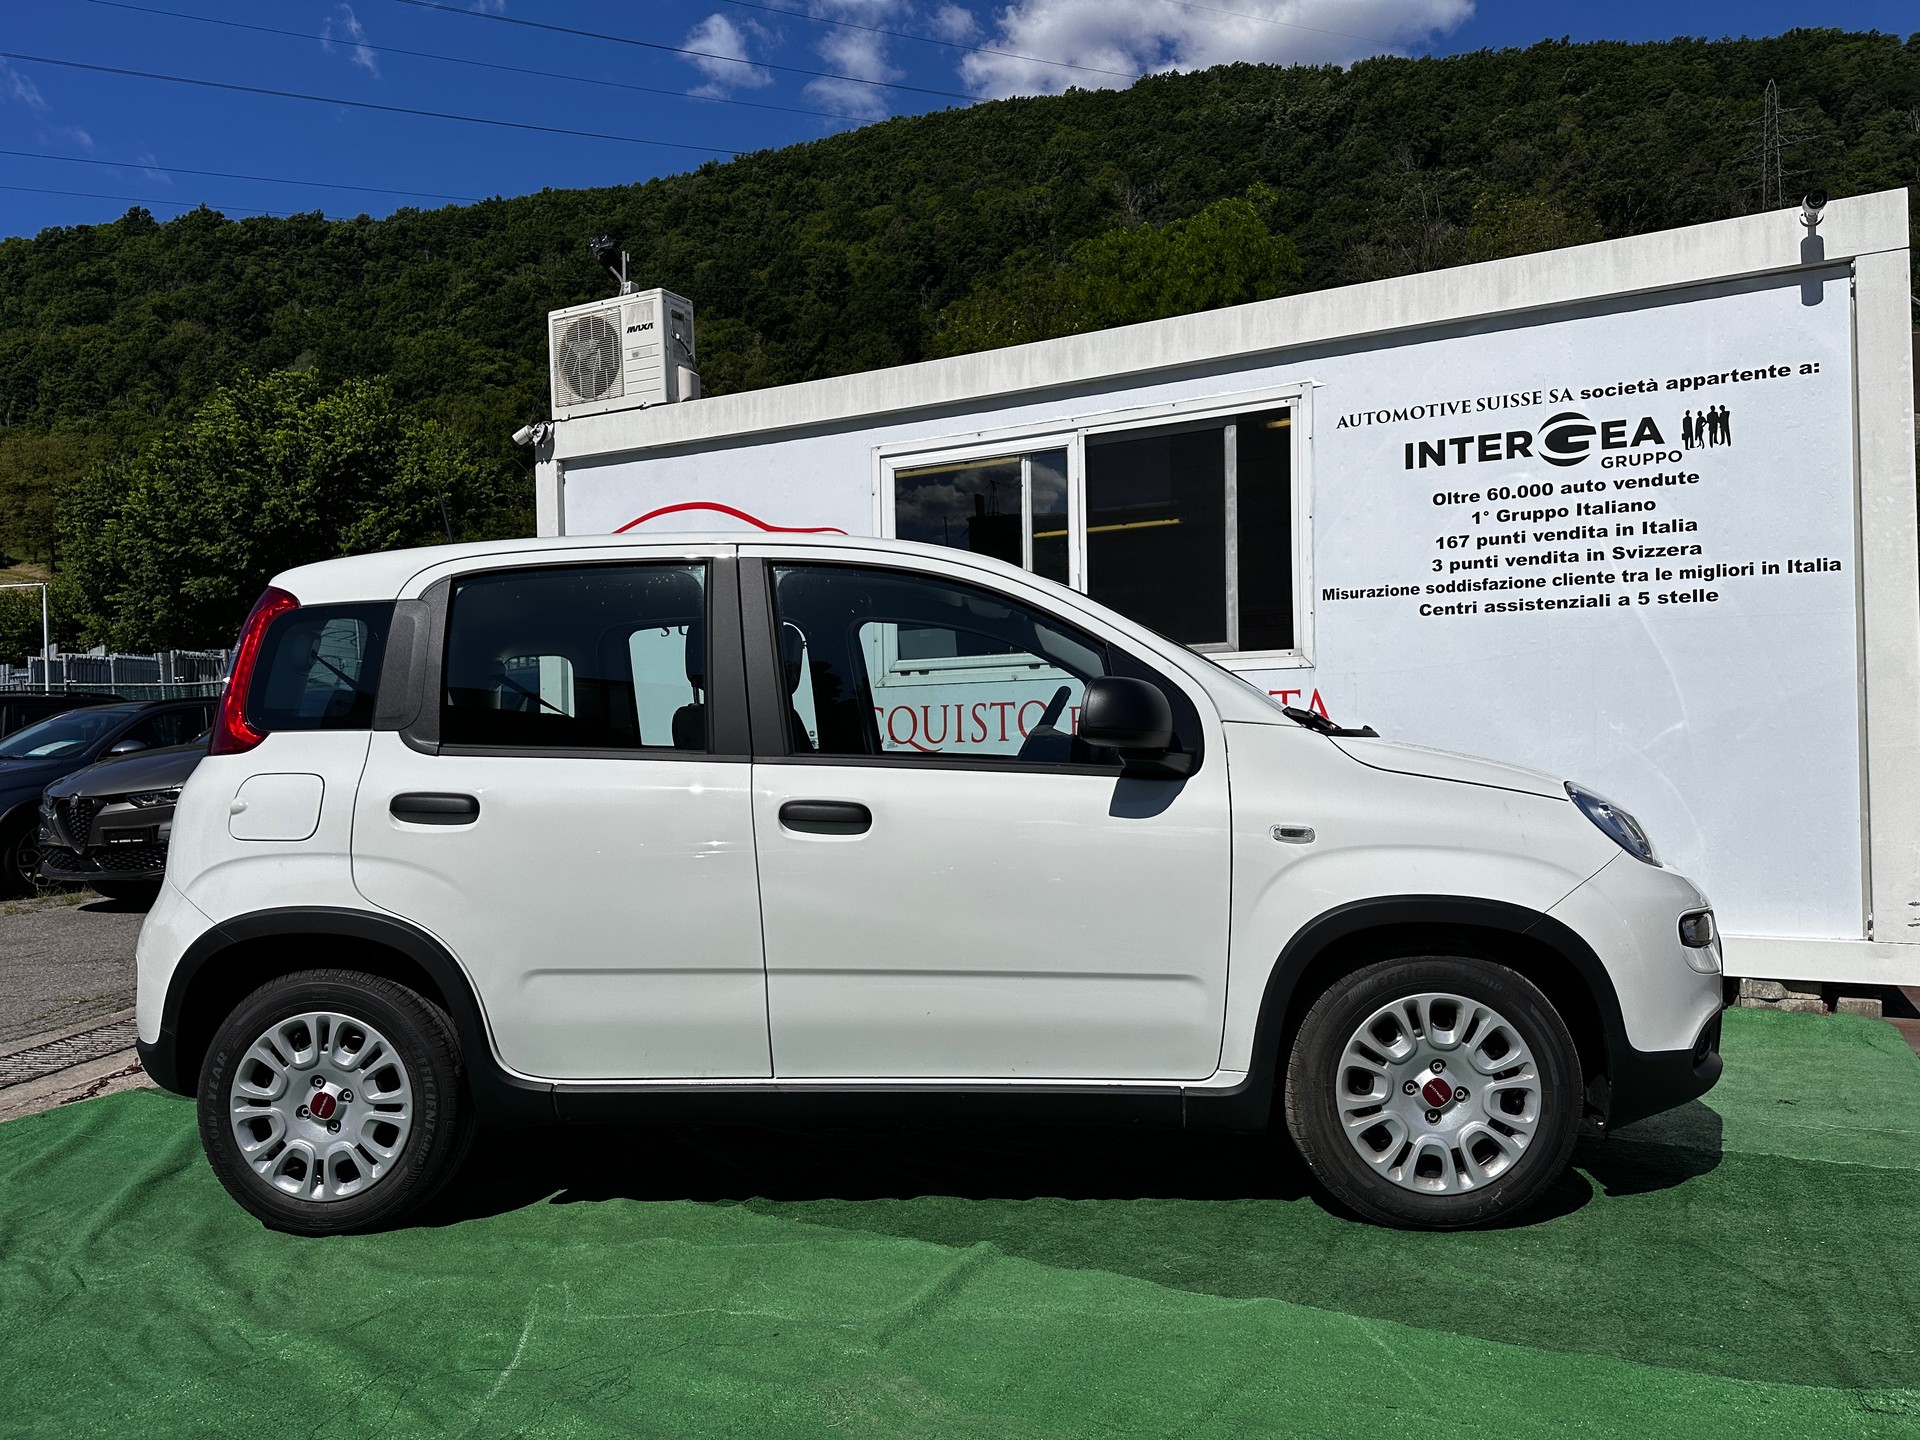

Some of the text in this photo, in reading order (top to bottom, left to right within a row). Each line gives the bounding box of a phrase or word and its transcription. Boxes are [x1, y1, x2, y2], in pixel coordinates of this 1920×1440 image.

[626, 322, 654, 334] MAXA
[1336, 362, 1820, 429] AUTOMOTIVE SUISSE SA società appartente a:
[1600, 449, 1683, 469] GRUPPO
[1432, 471, 1700, 506] Oltre 60.000 auto vendute
[1471, 500, 1657, 525] 1° Gruppo Italiano
[1435, 518, 1698, 550] 167 punti vendita in Italia
[1431, 544, 1703, 574] 3 punti vendita in Svizzera
[1322, 557, 1842, 601] Misurazione soddisfazione cliente tra le migliori in Italia
[1419, 588, 1719, 617] Centri assistenziali a 5 stelle
